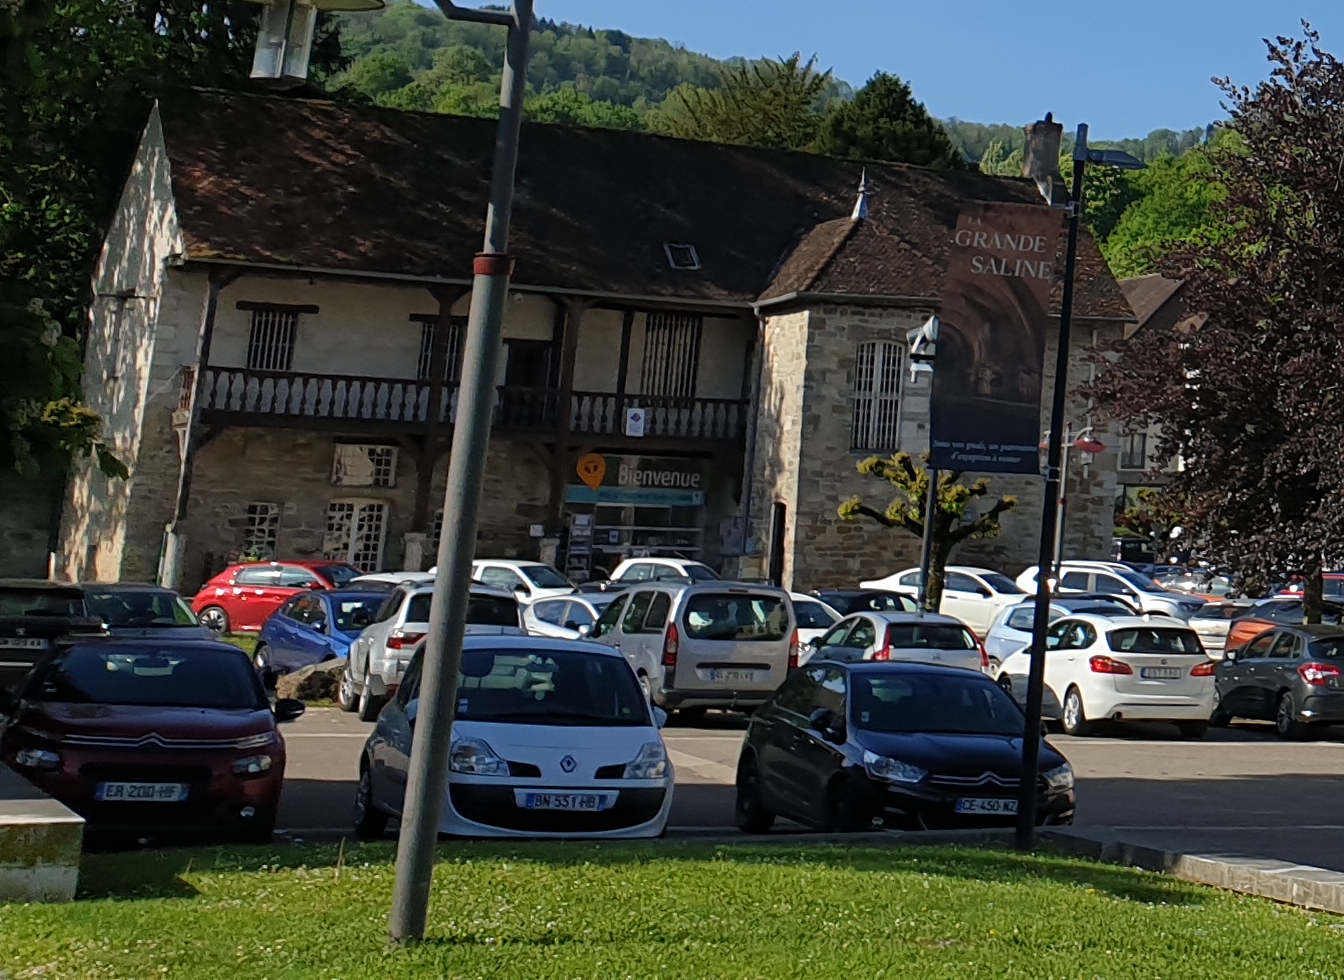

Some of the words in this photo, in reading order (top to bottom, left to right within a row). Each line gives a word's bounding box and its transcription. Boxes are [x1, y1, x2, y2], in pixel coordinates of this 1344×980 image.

[955, 229, 1047, 252] GRANDE
[970, 255, 1053, 279] SALINE
[618, 464, 700, 487] Bienvenue
